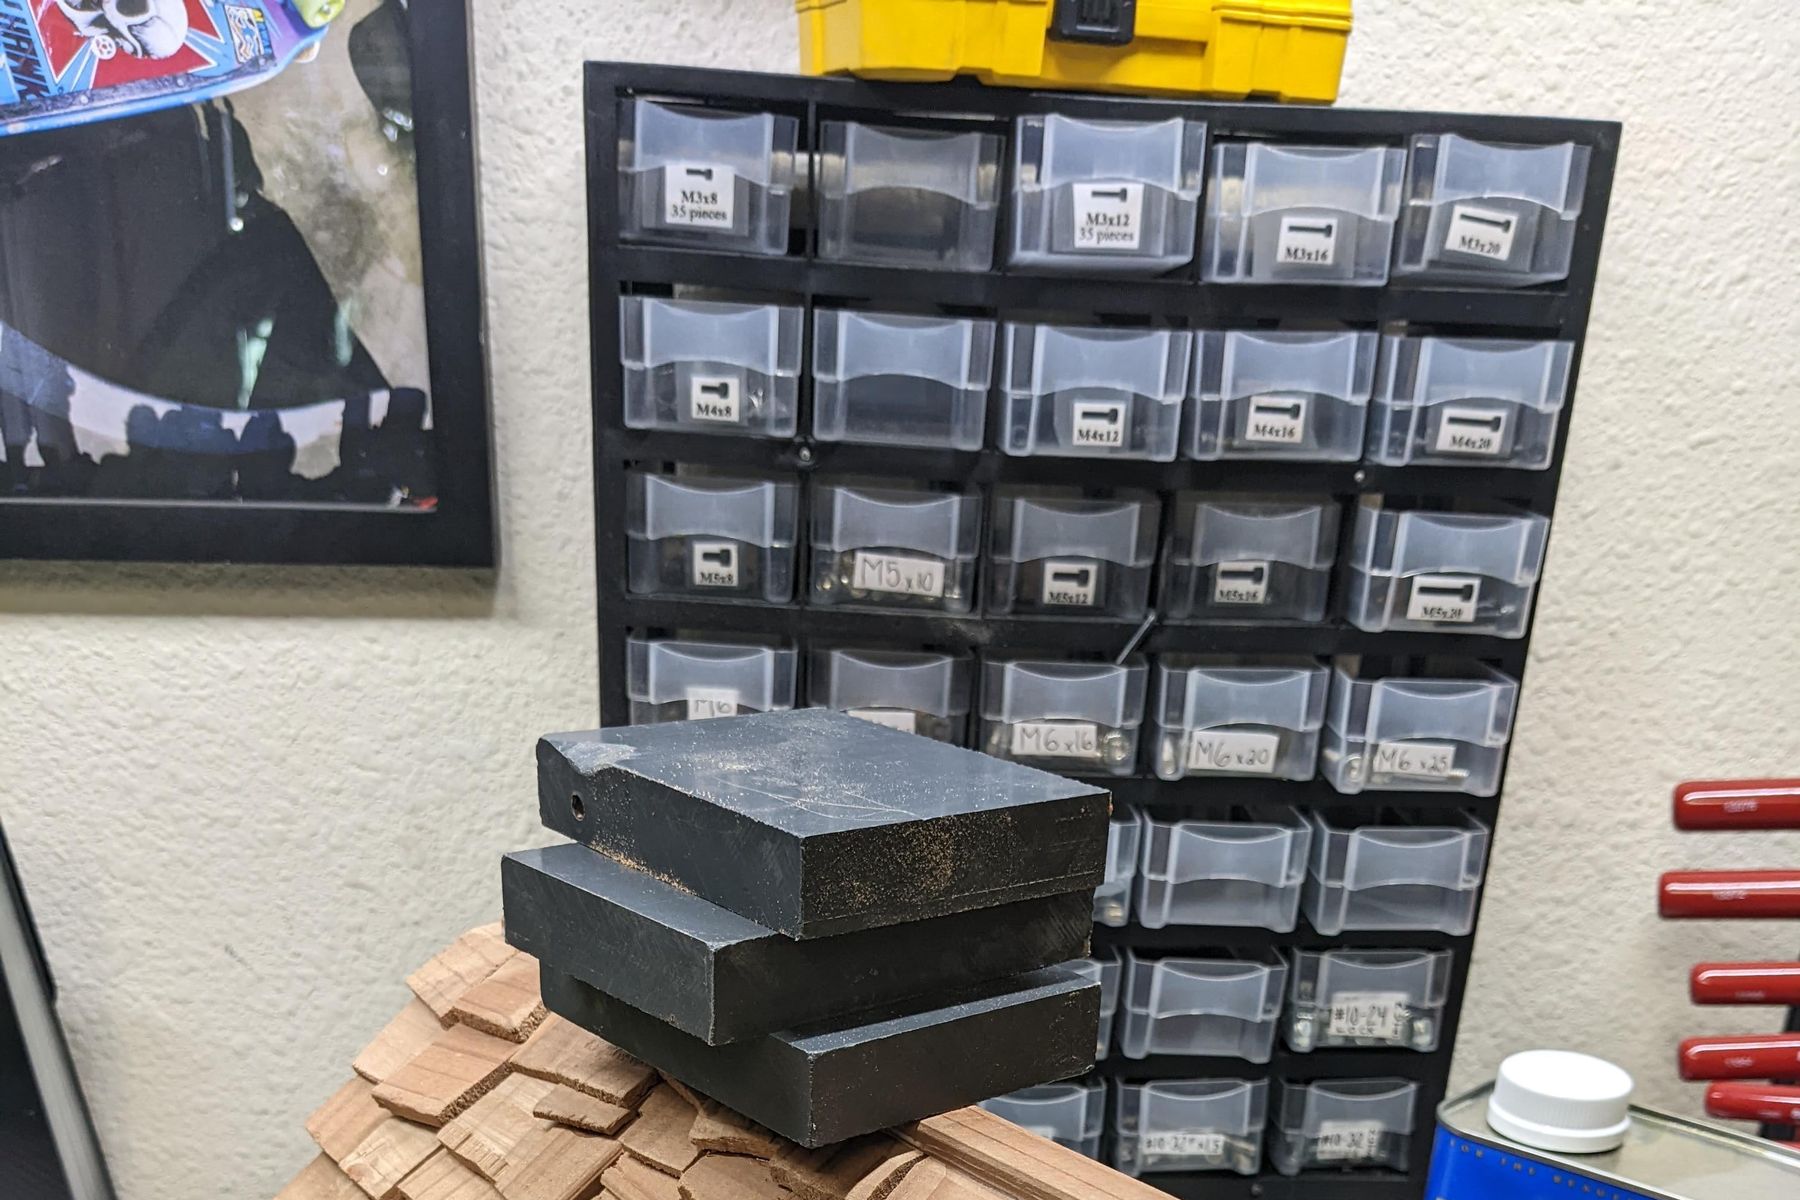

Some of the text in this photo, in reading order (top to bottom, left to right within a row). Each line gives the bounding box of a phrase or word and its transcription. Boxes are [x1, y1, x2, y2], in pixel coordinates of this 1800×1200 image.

[681, 190, 719, 205] M3x8
[671, 204, 728, 222] 35 pieces
[1086, 212, 1130, 227] M3x12
[1080, 227, 1134, 244] 35 pieces
[1459, 235, 1501, 255] M3x20
[1285, 246, 1328, 261] M3x16
[696, 402, 732, 417] M4x8
[1077, 429, 1120, 442] M4x12
[1253, 424, 1296, 439] M4x16
[1449, 435, 1491, 449] M4x20
[700, 572, 734, 585] M5x8
[861, 559, 935, 593] M5x10
[1047, 591, 1089, 604] M5x12
[1020, 727, 1094, 754] M6x16
[1334, 1004, 1386, 1028] #10-24
